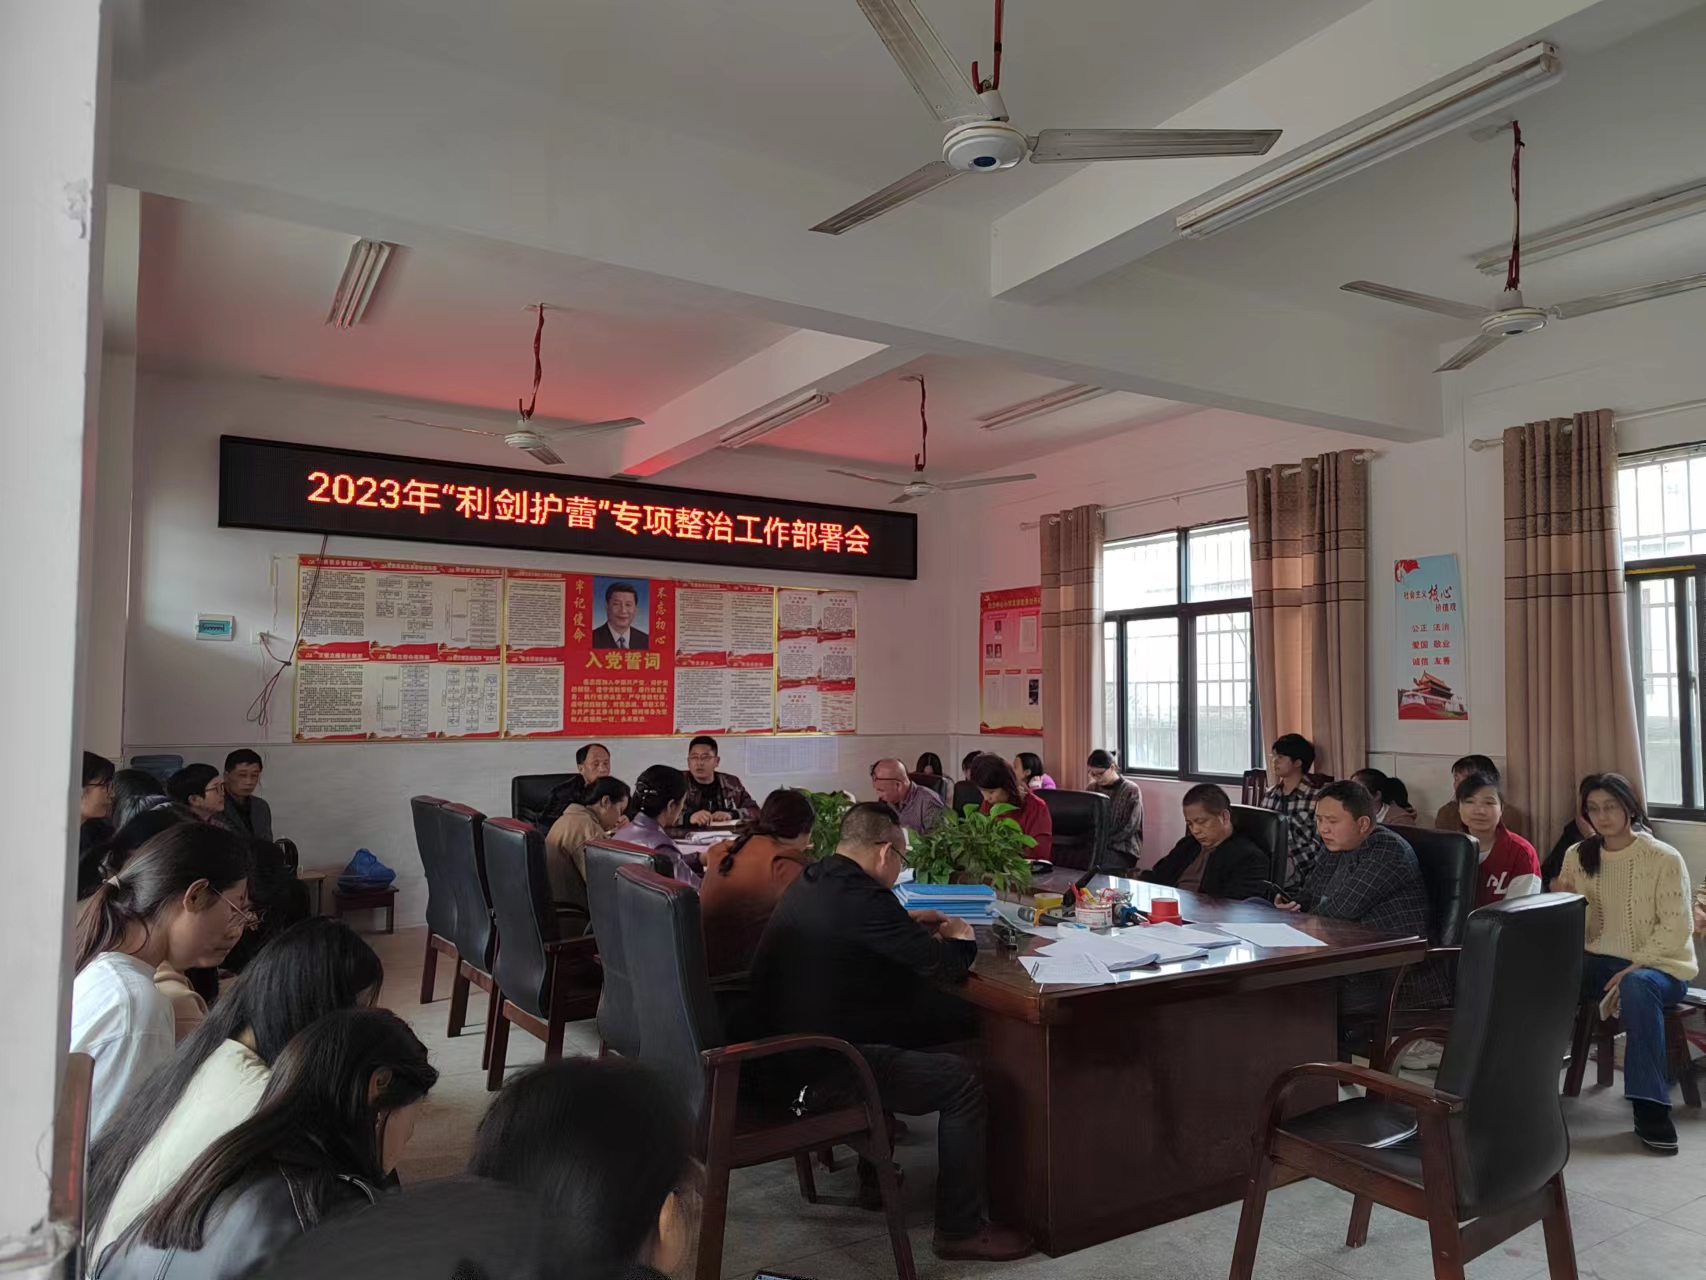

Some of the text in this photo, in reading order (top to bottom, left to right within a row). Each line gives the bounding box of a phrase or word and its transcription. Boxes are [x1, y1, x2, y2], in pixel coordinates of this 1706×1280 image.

[307, 471, 870, 554] 2023年“利剑护蕾”专项整治工作部署会
[573, 579, 585, 643] 牢记使命
[1435, 603, 1457, 612] 价值观
[655, 586, 667, 645] 不忘初心
[1412, 622, 1450, 633] 公正 法治
[1412, 640, 1451, 649] 爱国 敬业
[585, 651, 661, 670] 入党誓词
[1412, 656, 1450, 666] 诚信 友善
